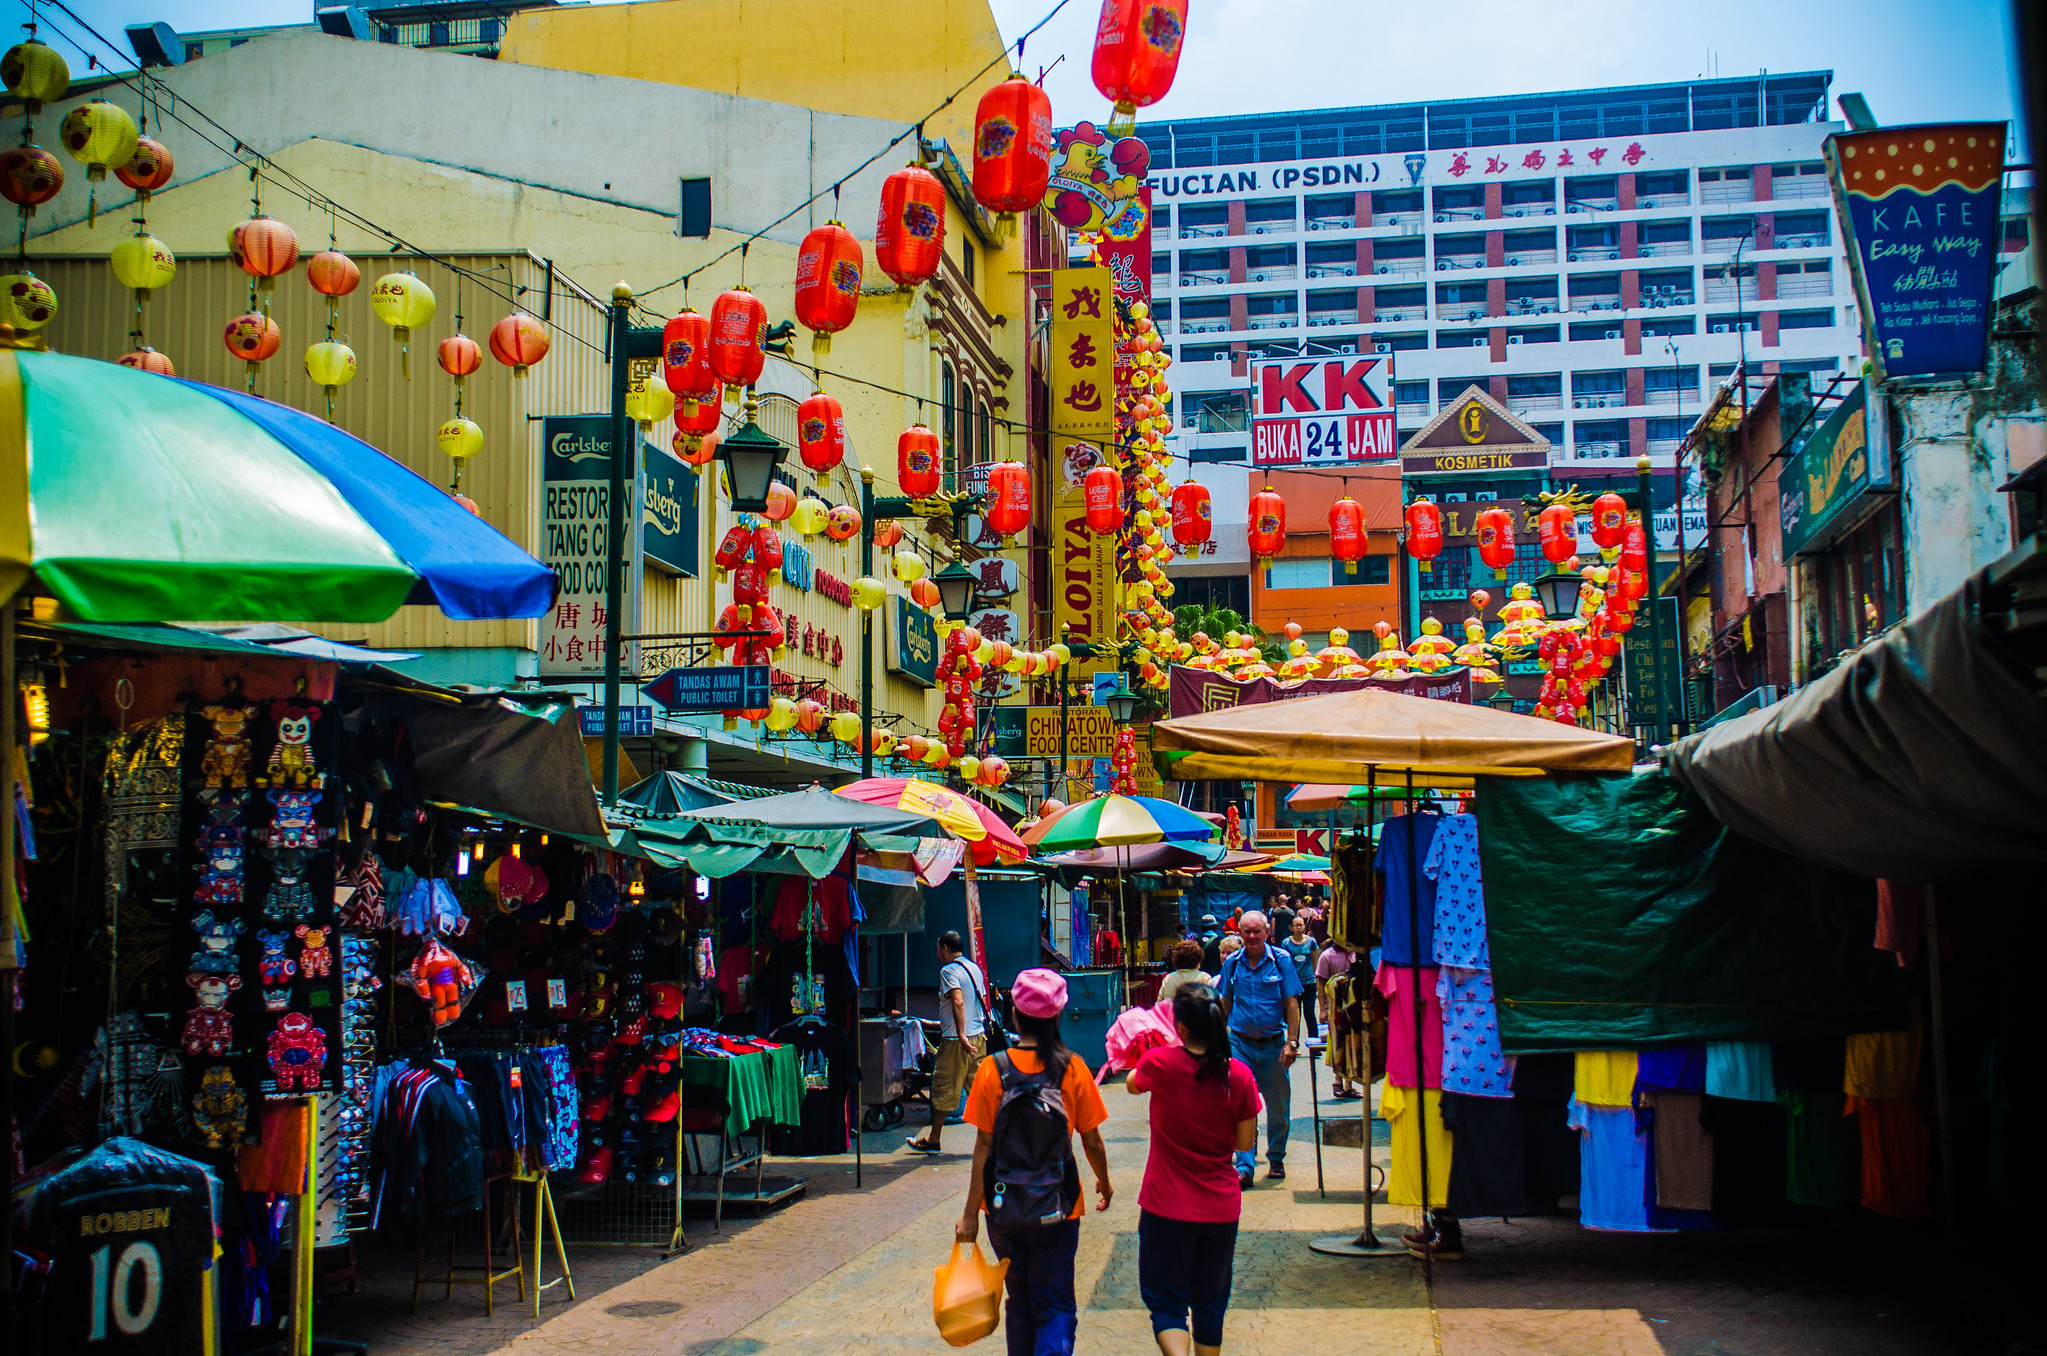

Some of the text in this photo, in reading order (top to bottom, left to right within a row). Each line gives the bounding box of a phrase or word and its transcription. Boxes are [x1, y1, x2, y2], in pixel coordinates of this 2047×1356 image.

[1052, 178, 1084, 191] OLOIYA
[1140, 171, 1258, 198] FUCIAN
[1871, 202, 1974, 232] KAFE
[1869, 234, 1983, 264] Easy Way
[1262, 359, 1384, 415] KK
[552, 432, 627, 458] Carlsbe
[1257, 417, 1393, 461] BUKA 24 JAM
[1435, 454, 1513, 471] KOSMETIK
[546, 486, 632, 520] RESTORN
[644, 472, 681, 534] lsberg
[547, 523, 630, 557] TANG CIY
[546, 560, 630, 595] OOD COT
[907, 615, 931, 662] Carlsberg
[1626, 637, 1675, 651] Restan
[679, 675, 740, 690] TANDAS AWAM
[680, 690, 738, 704] PUBLIC TOILET
[1635, 702, 1674, 714] Cene
[585, 711, 605, 721] TANDA
[587, 722, 605, 732] PUBLI
[1070, 736, 1114, 754] CENTR
[81, 1206, 172, 1237] ROBBEN
[88, 1240, 163, 1341] 10
